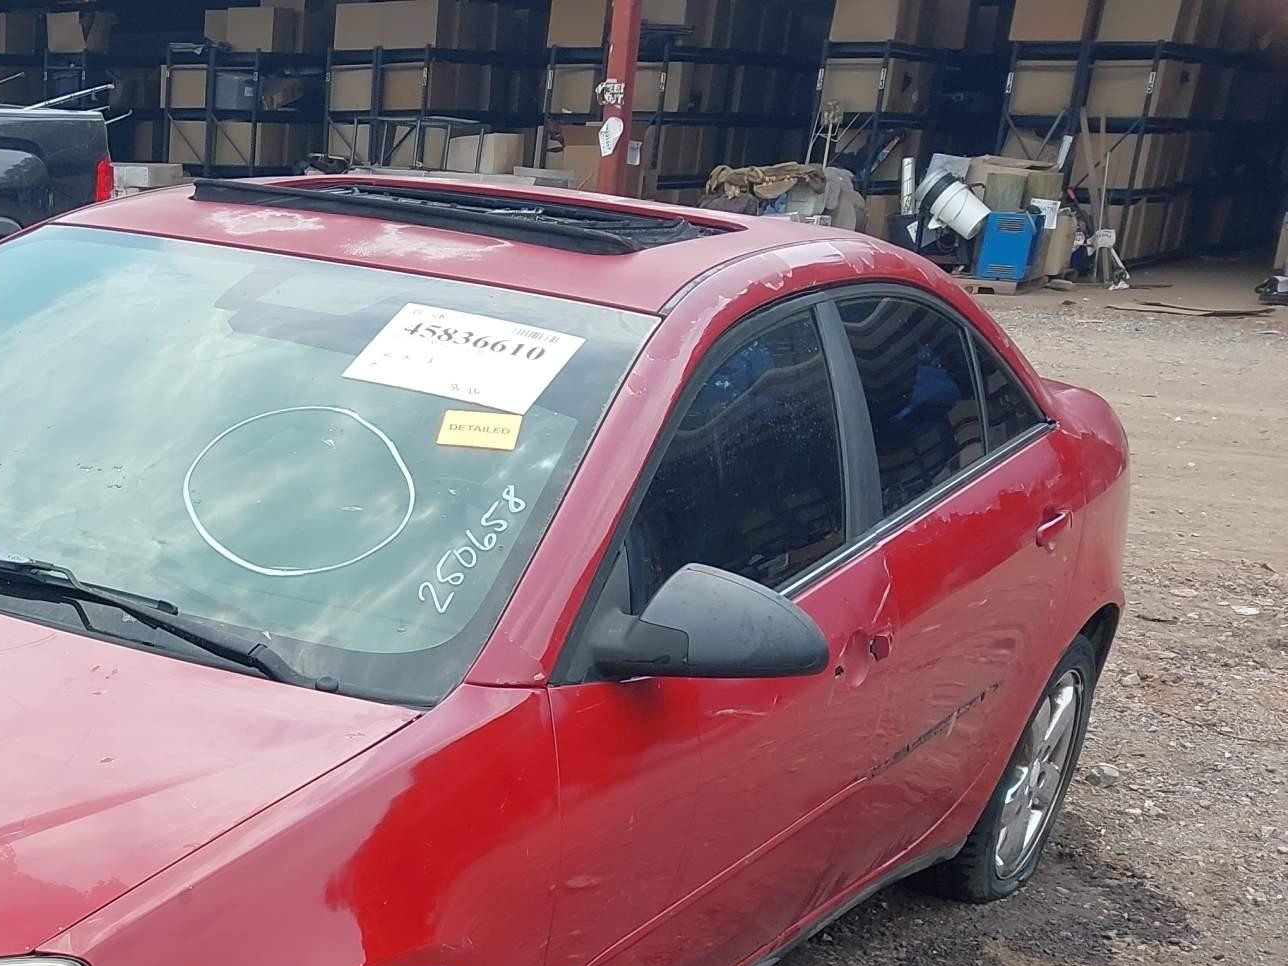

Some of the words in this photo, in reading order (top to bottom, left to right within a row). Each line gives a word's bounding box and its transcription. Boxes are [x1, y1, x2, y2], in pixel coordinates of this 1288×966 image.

[403, 322, 546, 362] 45836610
[448, 423, 511, 436] DETAILED
[418, 485, 526, 614] 250658
